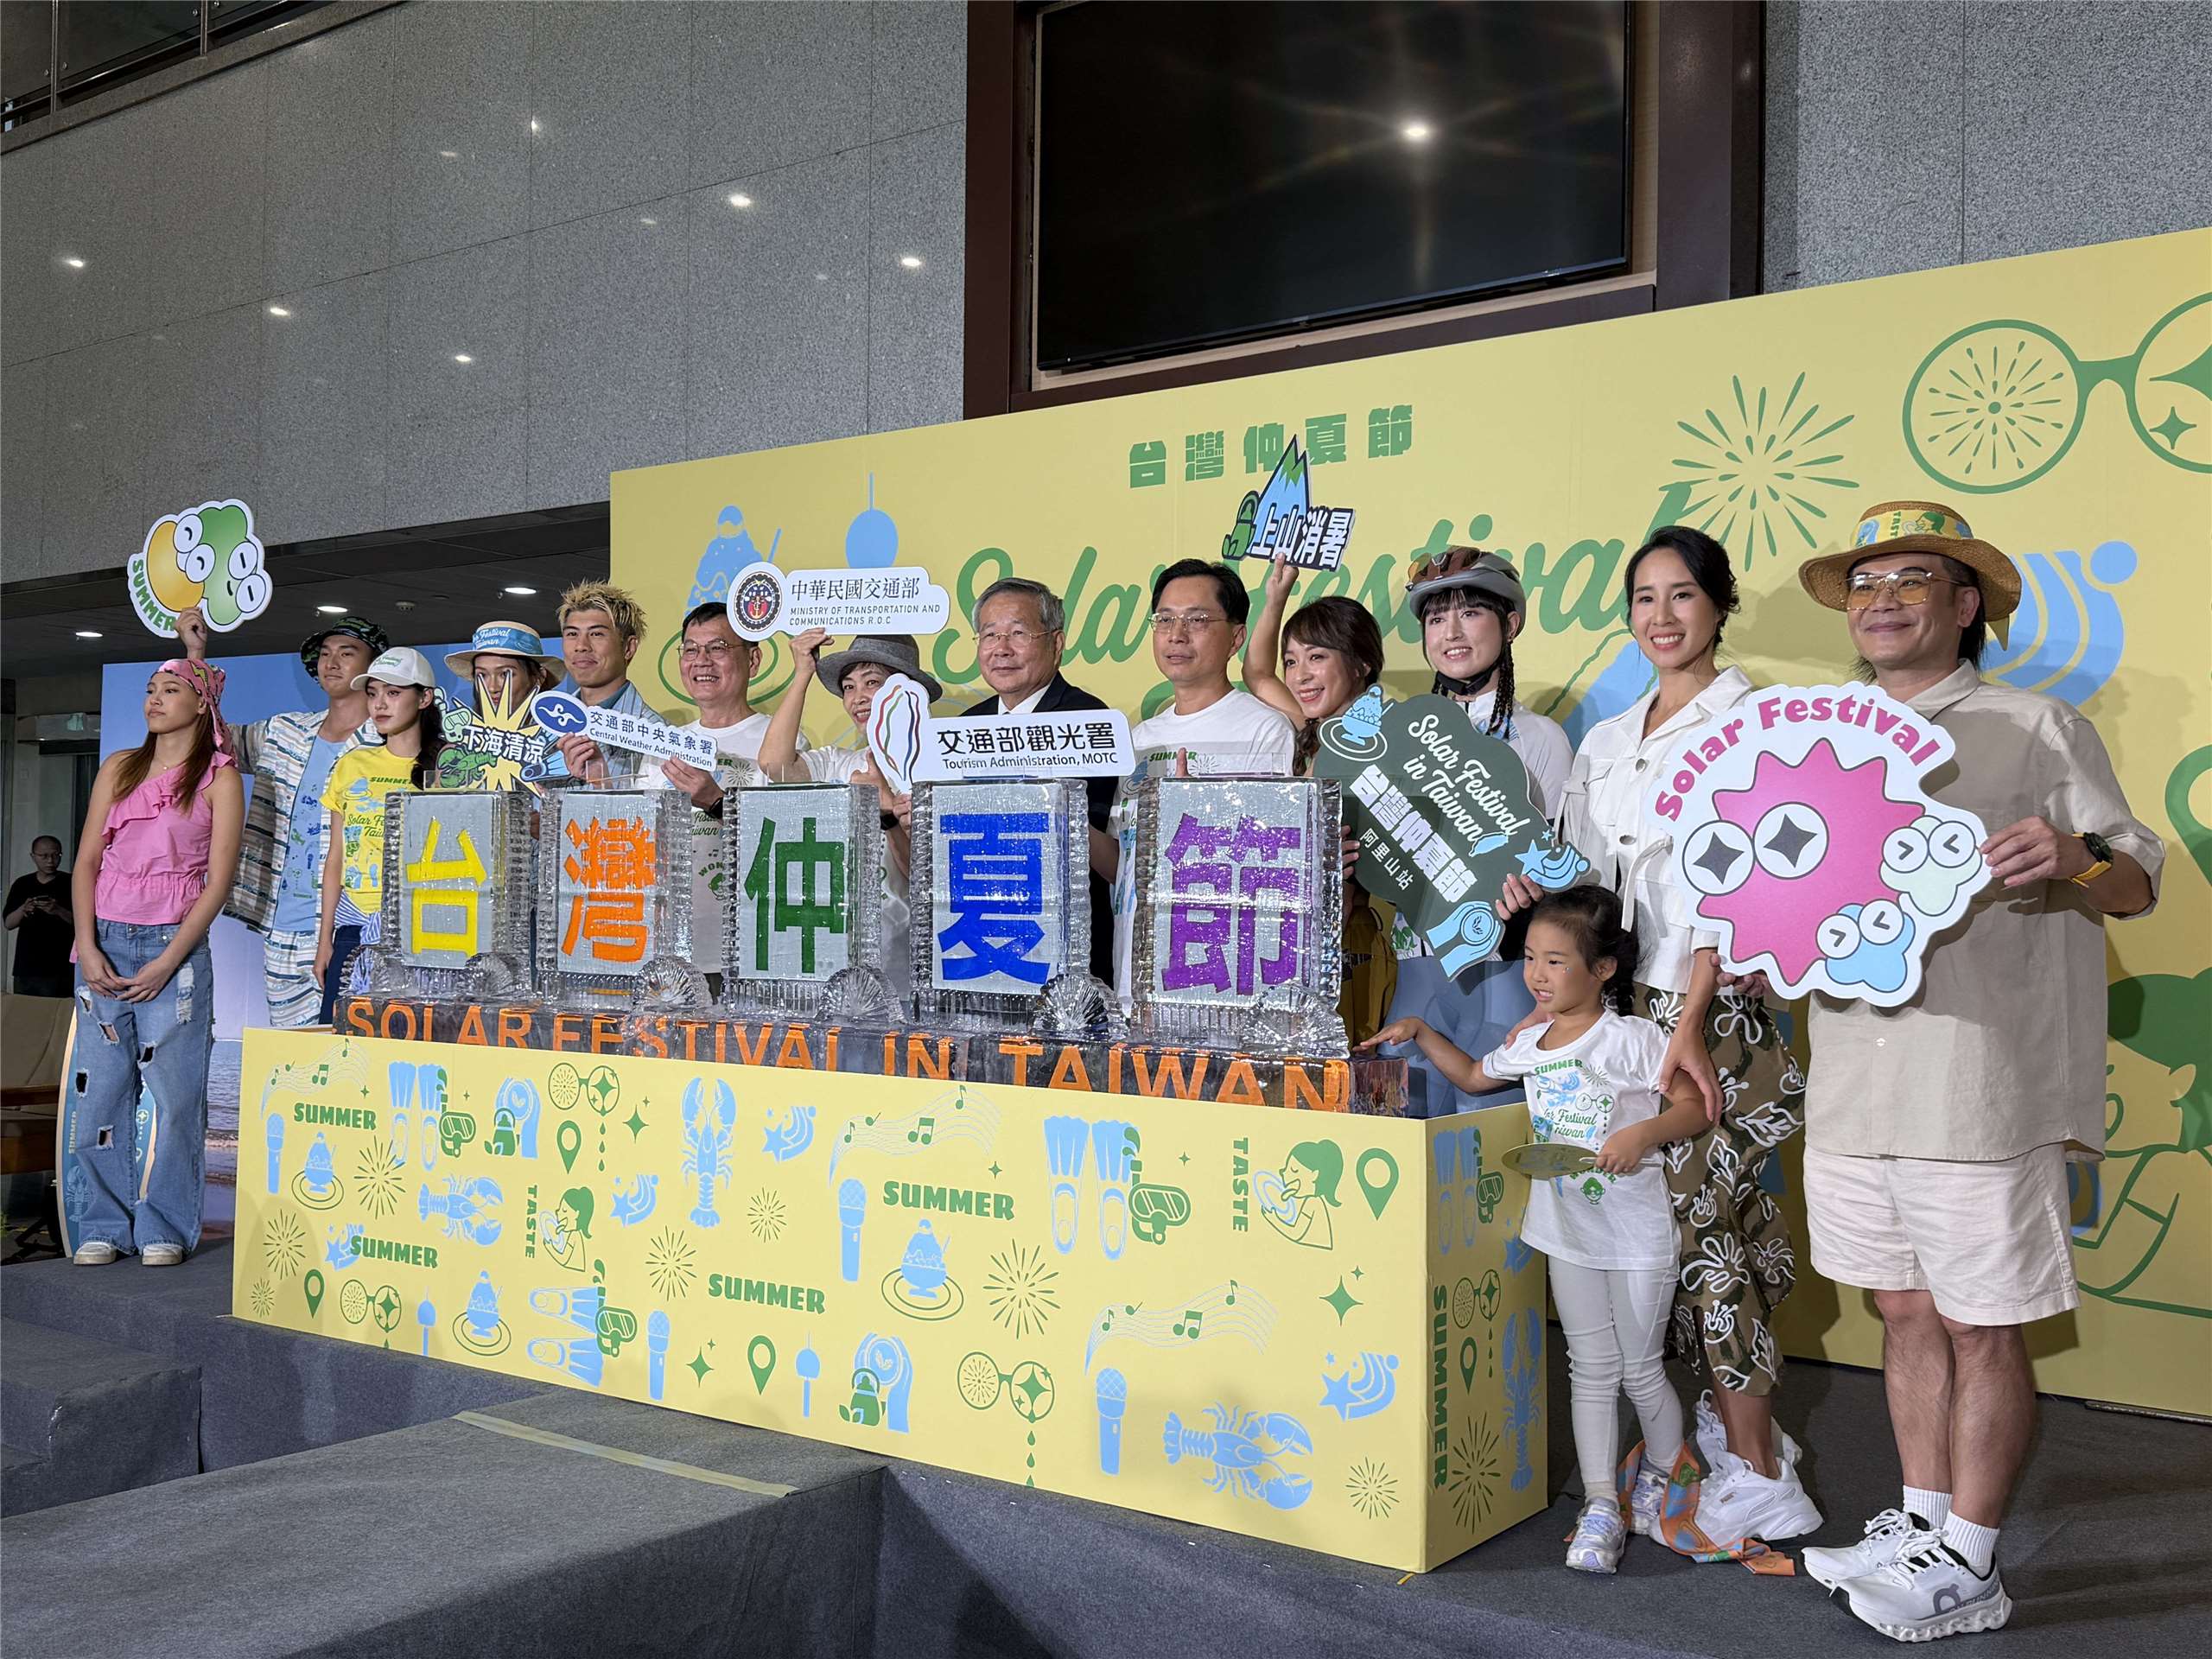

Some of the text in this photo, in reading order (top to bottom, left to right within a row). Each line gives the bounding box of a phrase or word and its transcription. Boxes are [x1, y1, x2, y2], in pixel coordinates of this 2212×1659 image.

[1129, 404, 1413, 489] 台灣仲夏節
[1250, 505, 1351, 569] 上山消暑
[1891, 512, 1901, 538] TAST
[132, 559, 177, 632] SUMMER
[791, 576, 920, 601] 中華民國交通部
[789, 616, 865, 626] COMMUNICATIONS
[790, 604, 941, 615] MINISTRY OF TRANSPORTATION AND
[461, 725, 546, 765] 下海清涼
[589, 710, 714, 755] 交通部中央氣象署
[589, 727, 618, 742] Central
[619, 735, 652, 751] Weather
[654, 744, 713, 767] Administration
[937, 722, 1116, 755] 交通部觀光署
[943, 752, 1118, 769] Tourism Administration, MOTC
[1408, 714, 1531, 836] Solar Festival
[1654, 694, 1942, 823] Solar Festival
[370, 776, 411, 785] SUMME
[1402, 753, 1484, 843] in Taiwan
[1349, 764, 1478, 903] 台灣仲夏節
[1359, 827, 1414, 891] 阿里山站
[884, 1030, 953, 1080] IN
[999, 1035, 1350, 1112] TAIWAN
[1534, 1058, 1583, 1075] SUMMER
[294, 1103, 377, 1130] SUMMER
[1558, 1109, 1599, 1125] Festival
[882, 1180, 1015, 1221] SUMMER
[1234, 1137, 1249, 1233] TASTE
[525, 1185, 537, 1259] TASTE
[350, 1235, 439, 1268] SUMMER
[708, 1274, 825, 1315] SUMMER
[1433, 1284, 1449, 1490] SUMMER
